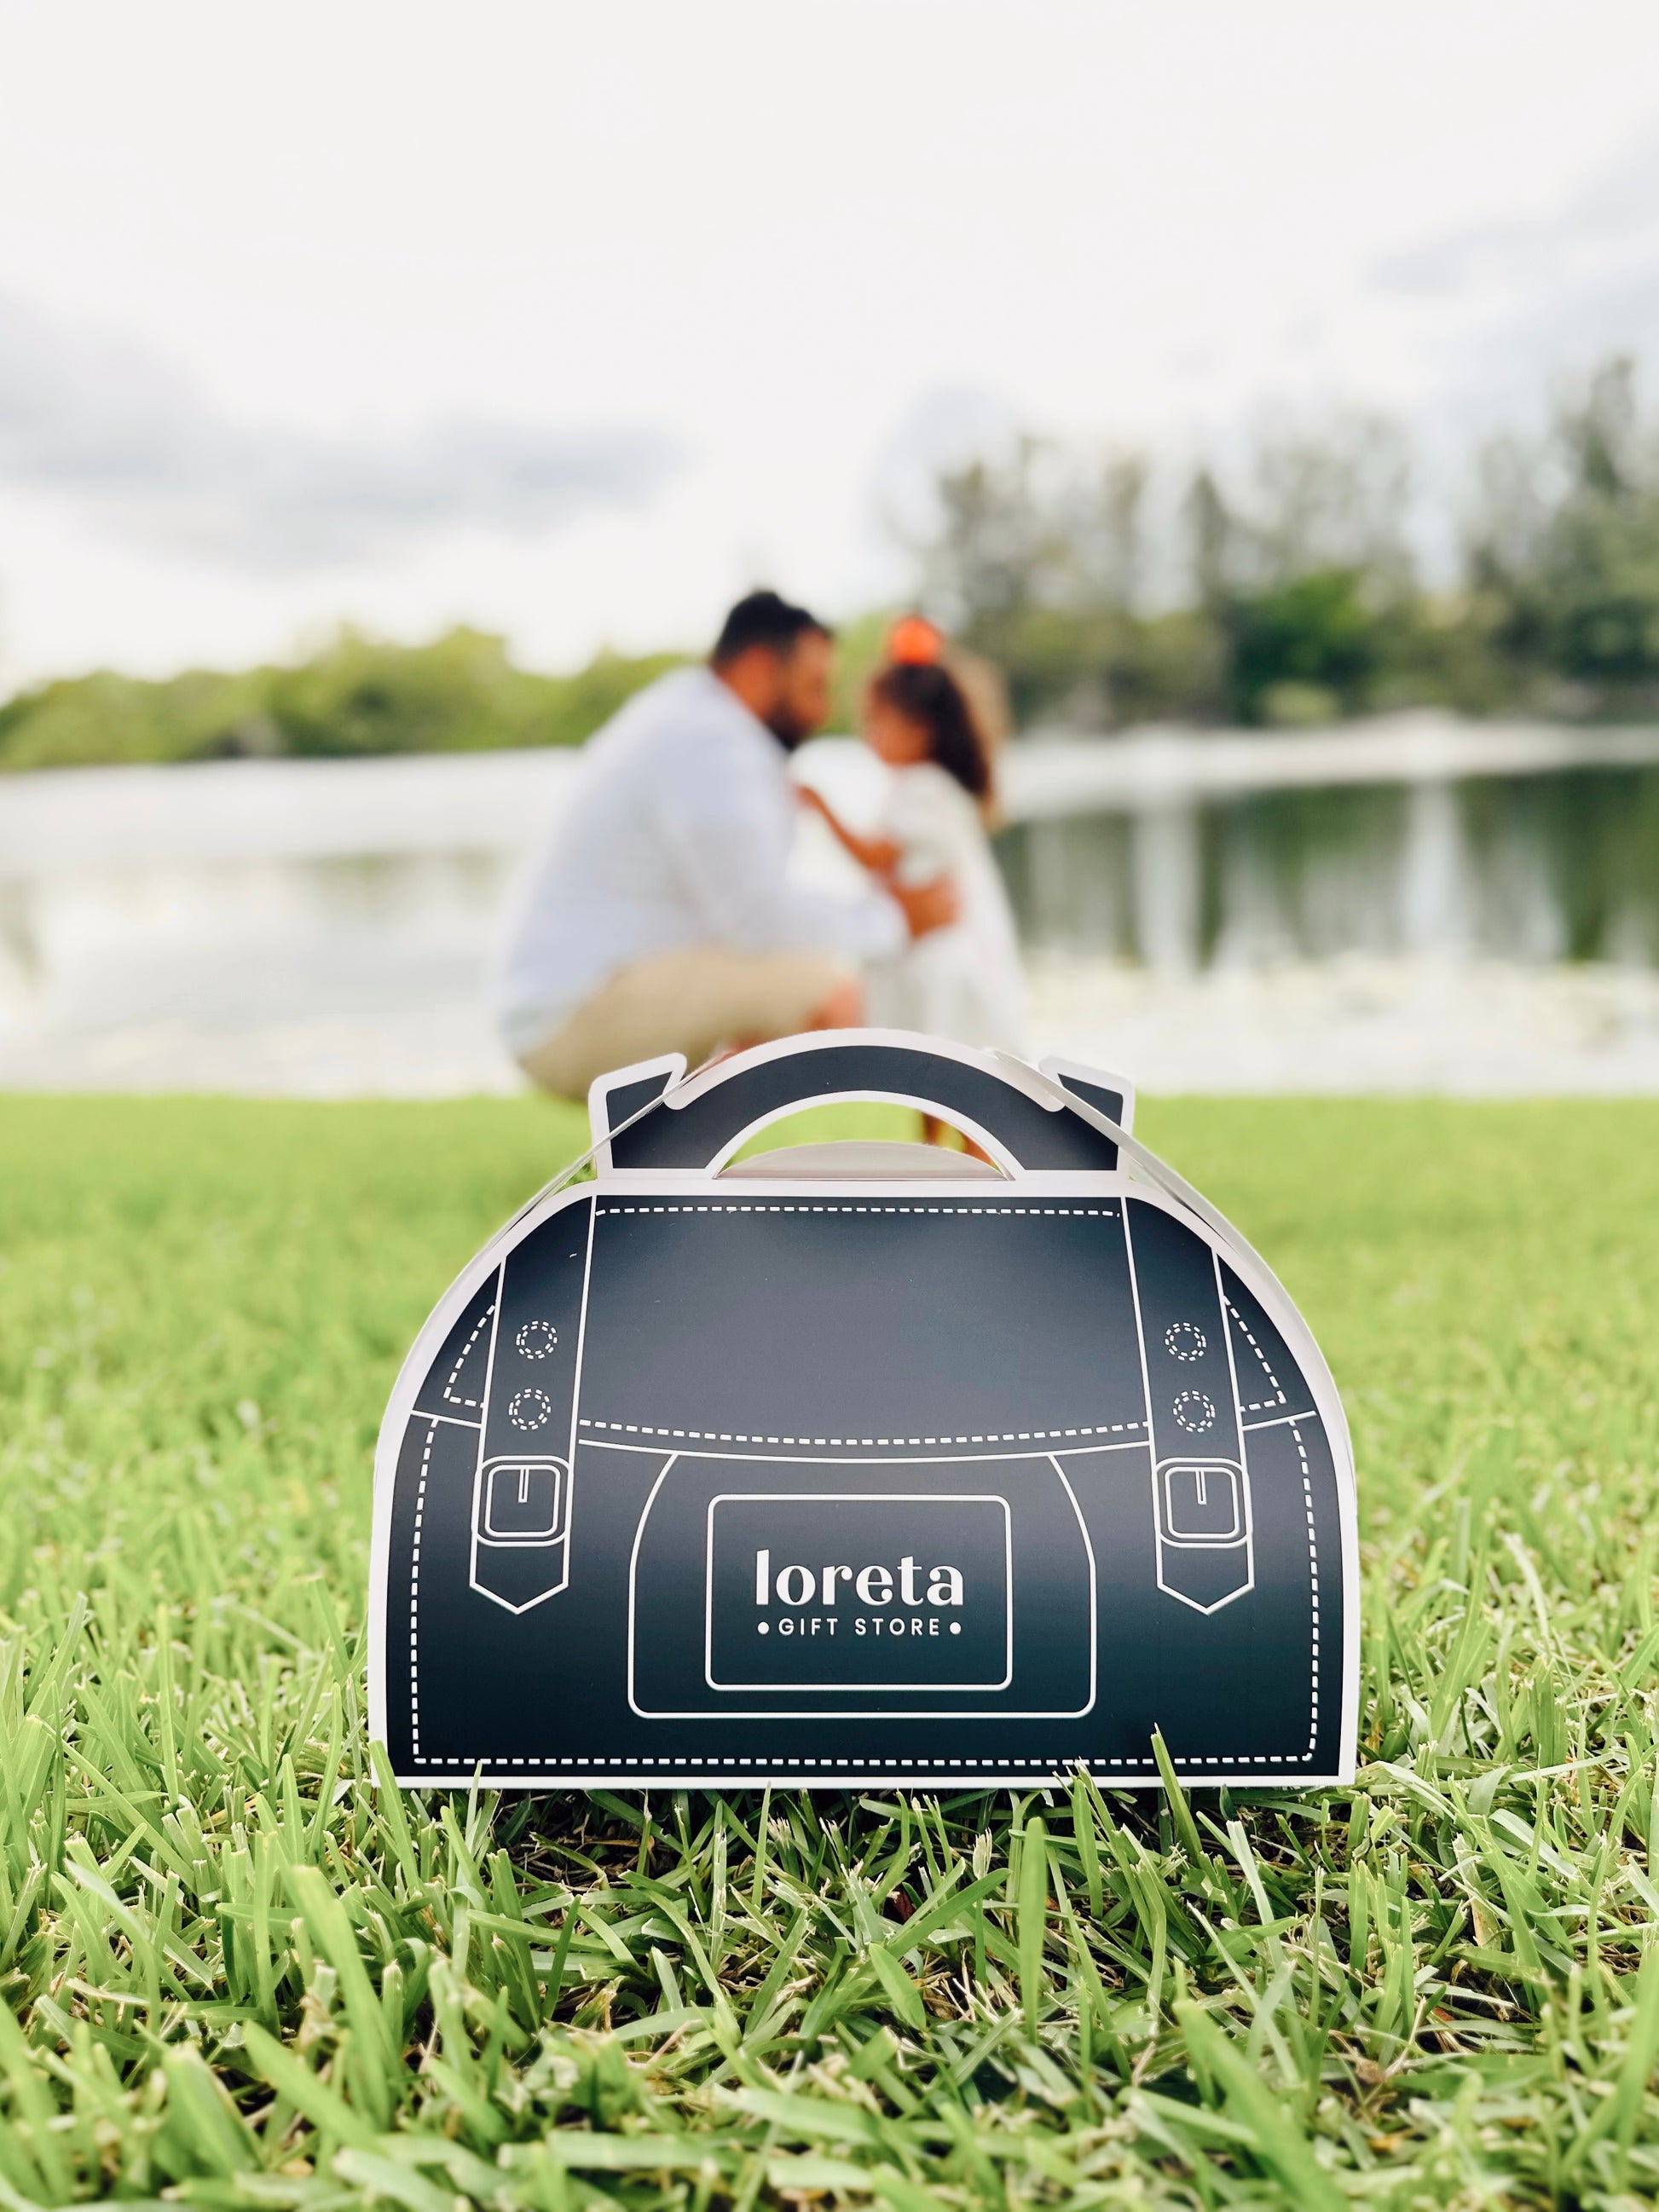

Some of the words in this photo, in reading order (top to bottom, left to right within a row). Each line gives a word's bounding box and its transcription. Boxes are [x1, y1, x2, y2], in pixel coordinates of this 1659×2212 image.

[755, 1549, 963, 1607] loreta
[778, 1618, 838, 1636] GIFT
[854, 1618, 939, 1636] STORE
